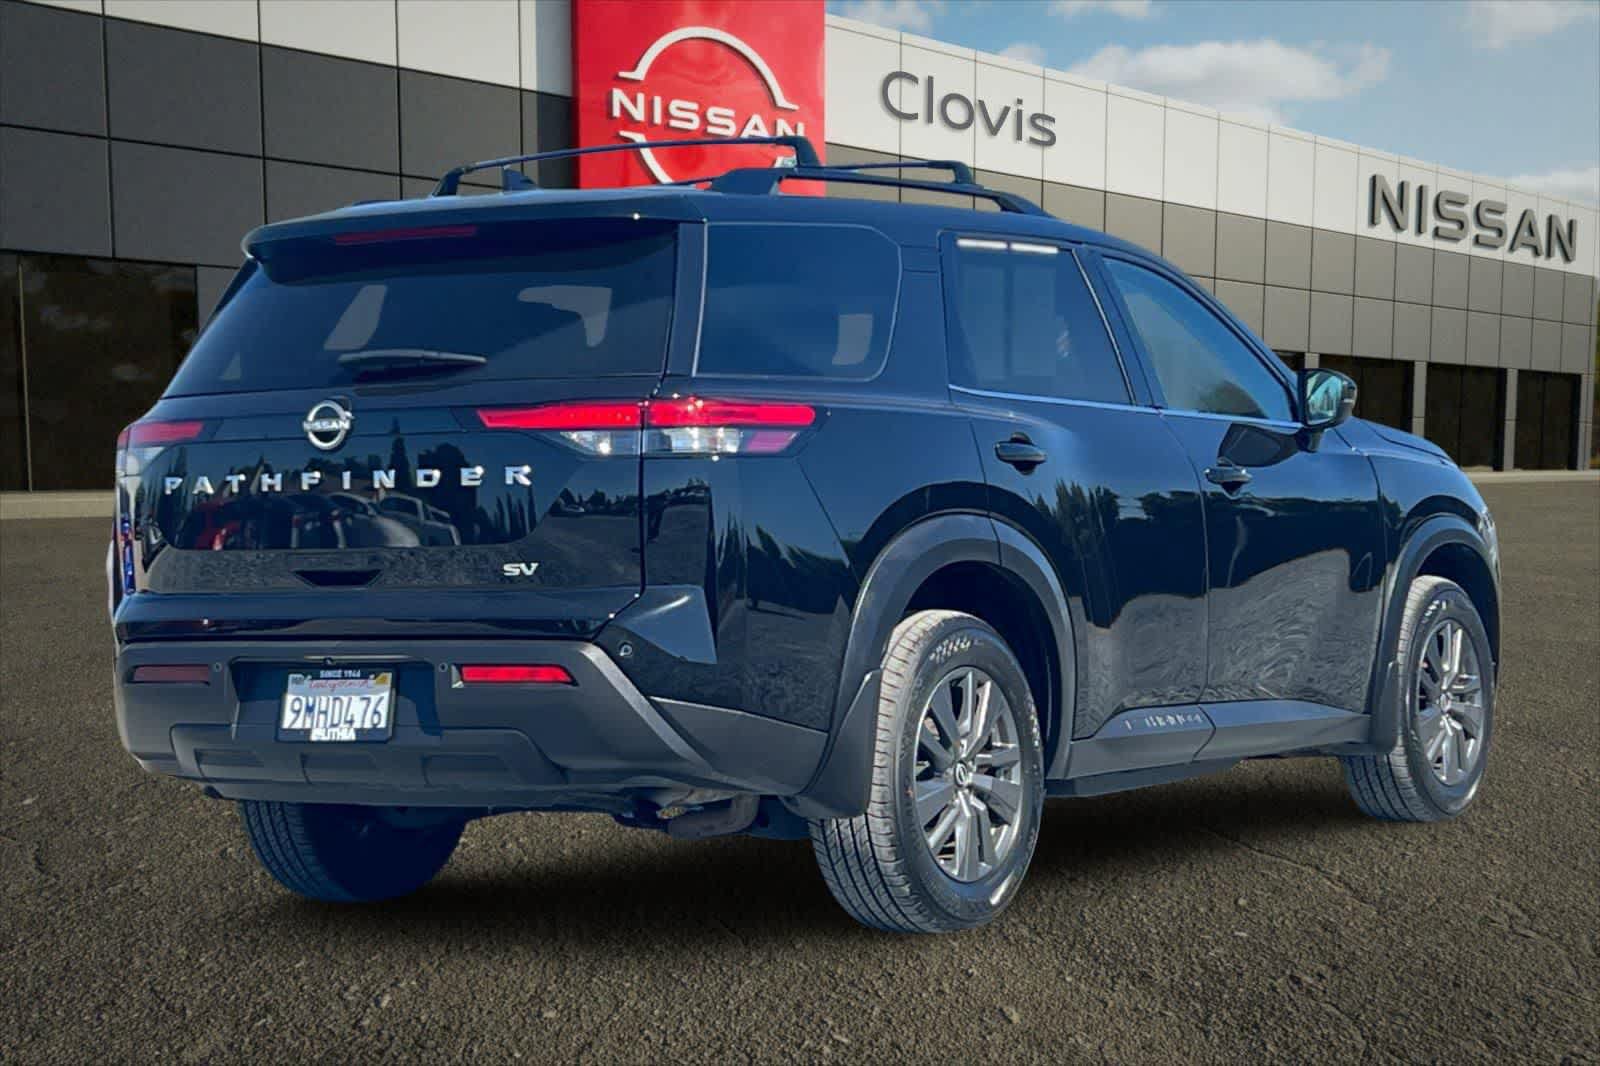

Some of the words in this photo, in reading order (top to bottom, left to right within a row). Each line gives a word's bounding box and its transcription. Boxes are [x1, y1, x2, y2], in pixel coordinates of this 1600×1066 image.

[609, 87, 805, 139] NISSAN
[881, 70, 1058, 147] Clovis
[1369, 173, 1578, 264] NISSAN
[303, 417, 350, 433] NISSAN
[164, 465, 532, 495] PATHFINDER
[503, 562, 539, 577] SV
[289, 695, 385, 729] 9MHD476
